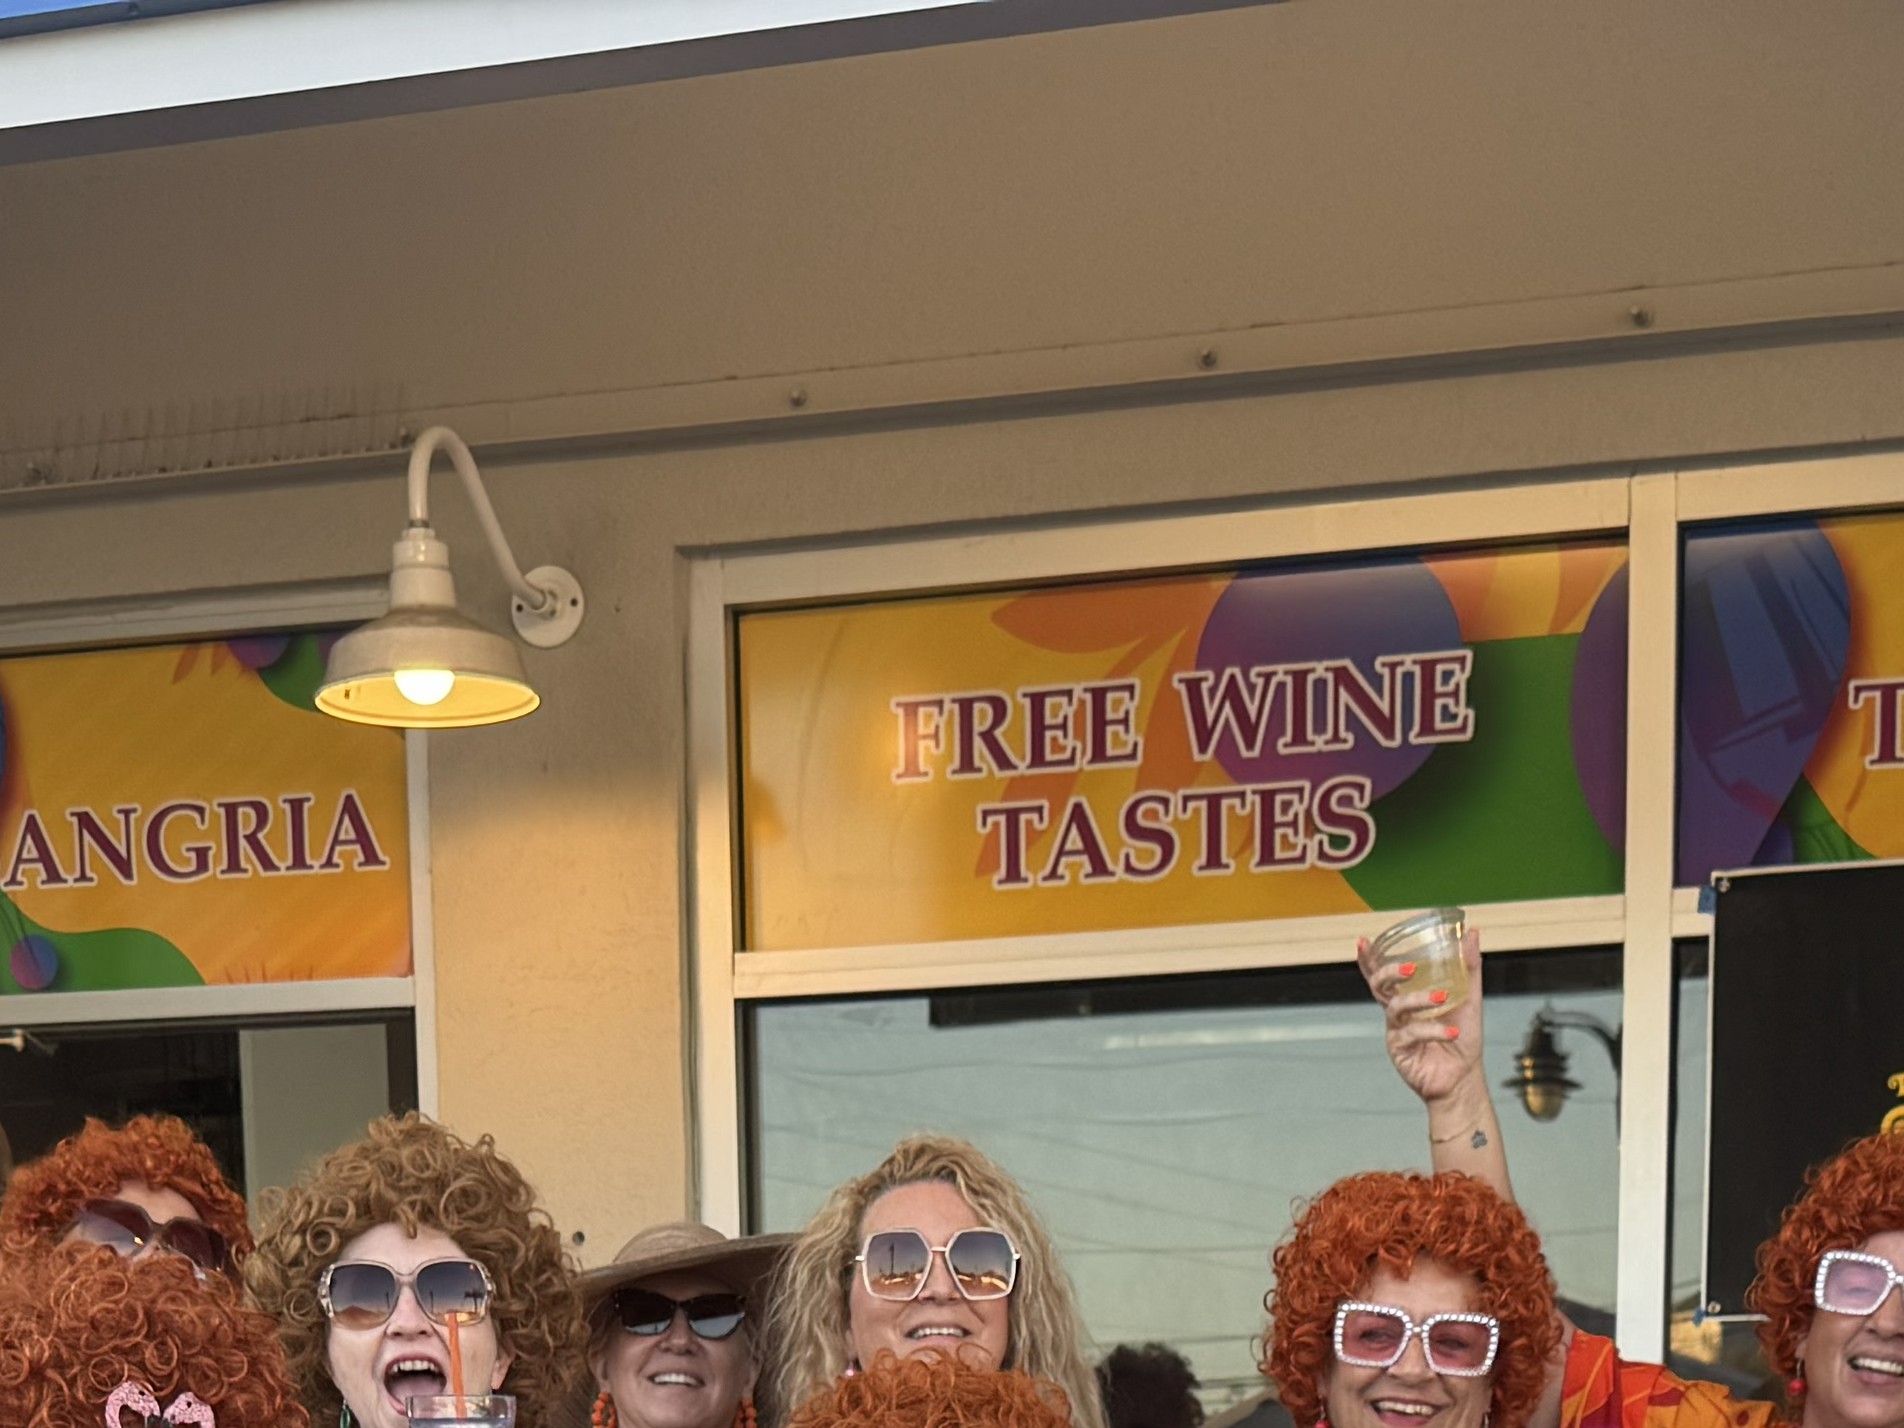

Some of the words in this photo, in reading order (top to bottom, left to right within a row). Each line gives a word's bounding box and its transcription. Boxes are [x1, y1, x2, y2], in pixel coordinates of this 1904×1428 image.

[891, 679, 1140, 784] FREE
[1173, 649, 1475, 761] WINE
[977, 775, 1376, 890] TASTES
